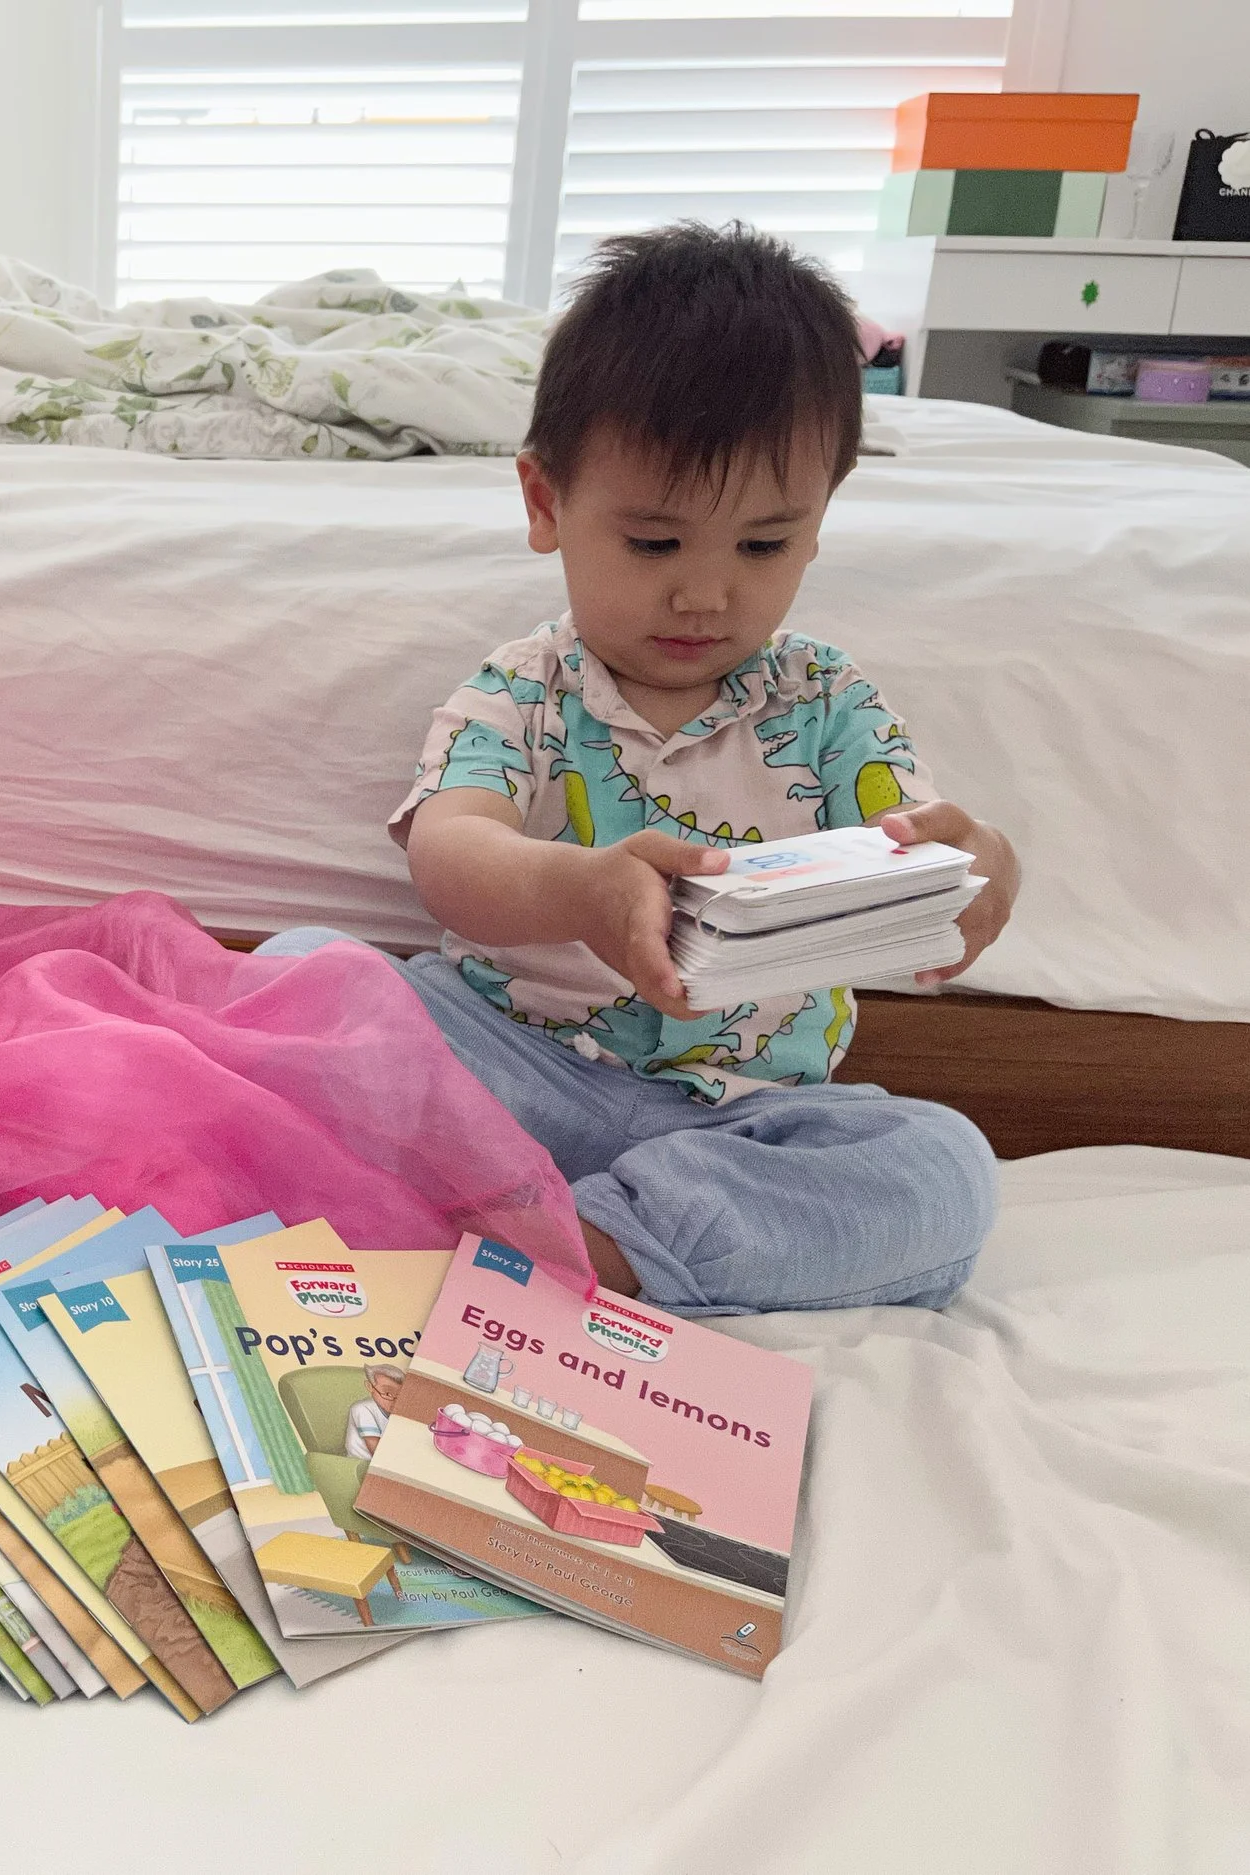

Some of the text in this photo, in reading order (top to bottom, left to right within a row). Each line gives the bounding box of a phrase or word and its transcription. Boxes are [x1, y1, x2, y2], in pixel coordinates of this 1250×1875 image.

[1219, 186, 1250, 197] CHAN
[172, 1257, 220, 1268] Story 25
[287, 1263, 353, 1272] SCHOLASTIC
[481, 1249, 528, 1273] Story 29
[290, 1279, 357, 1294] Forward
[19, 1299, 39, 1313] Sto
[70, 1295, 115, 1315] Story 10
[295, 1291, 363, 1306] Phonics
[599, 1300, 672, 1334] SCHOLASTIC
[587, 1322, 659, 1358] Phonics
[590, 1311, 663, 1349] Forward
[235, 1326, 421, 1365] Pop's soc
[460, 1304, 772, 1448] Eggs and lemons
[487, 1536, 634, 1607] Story by Paul George
[397, 1591, 429, 1603] Story
[432, 1590, 448, 1602] by
[451, 1587, 478, 1599] Paul
